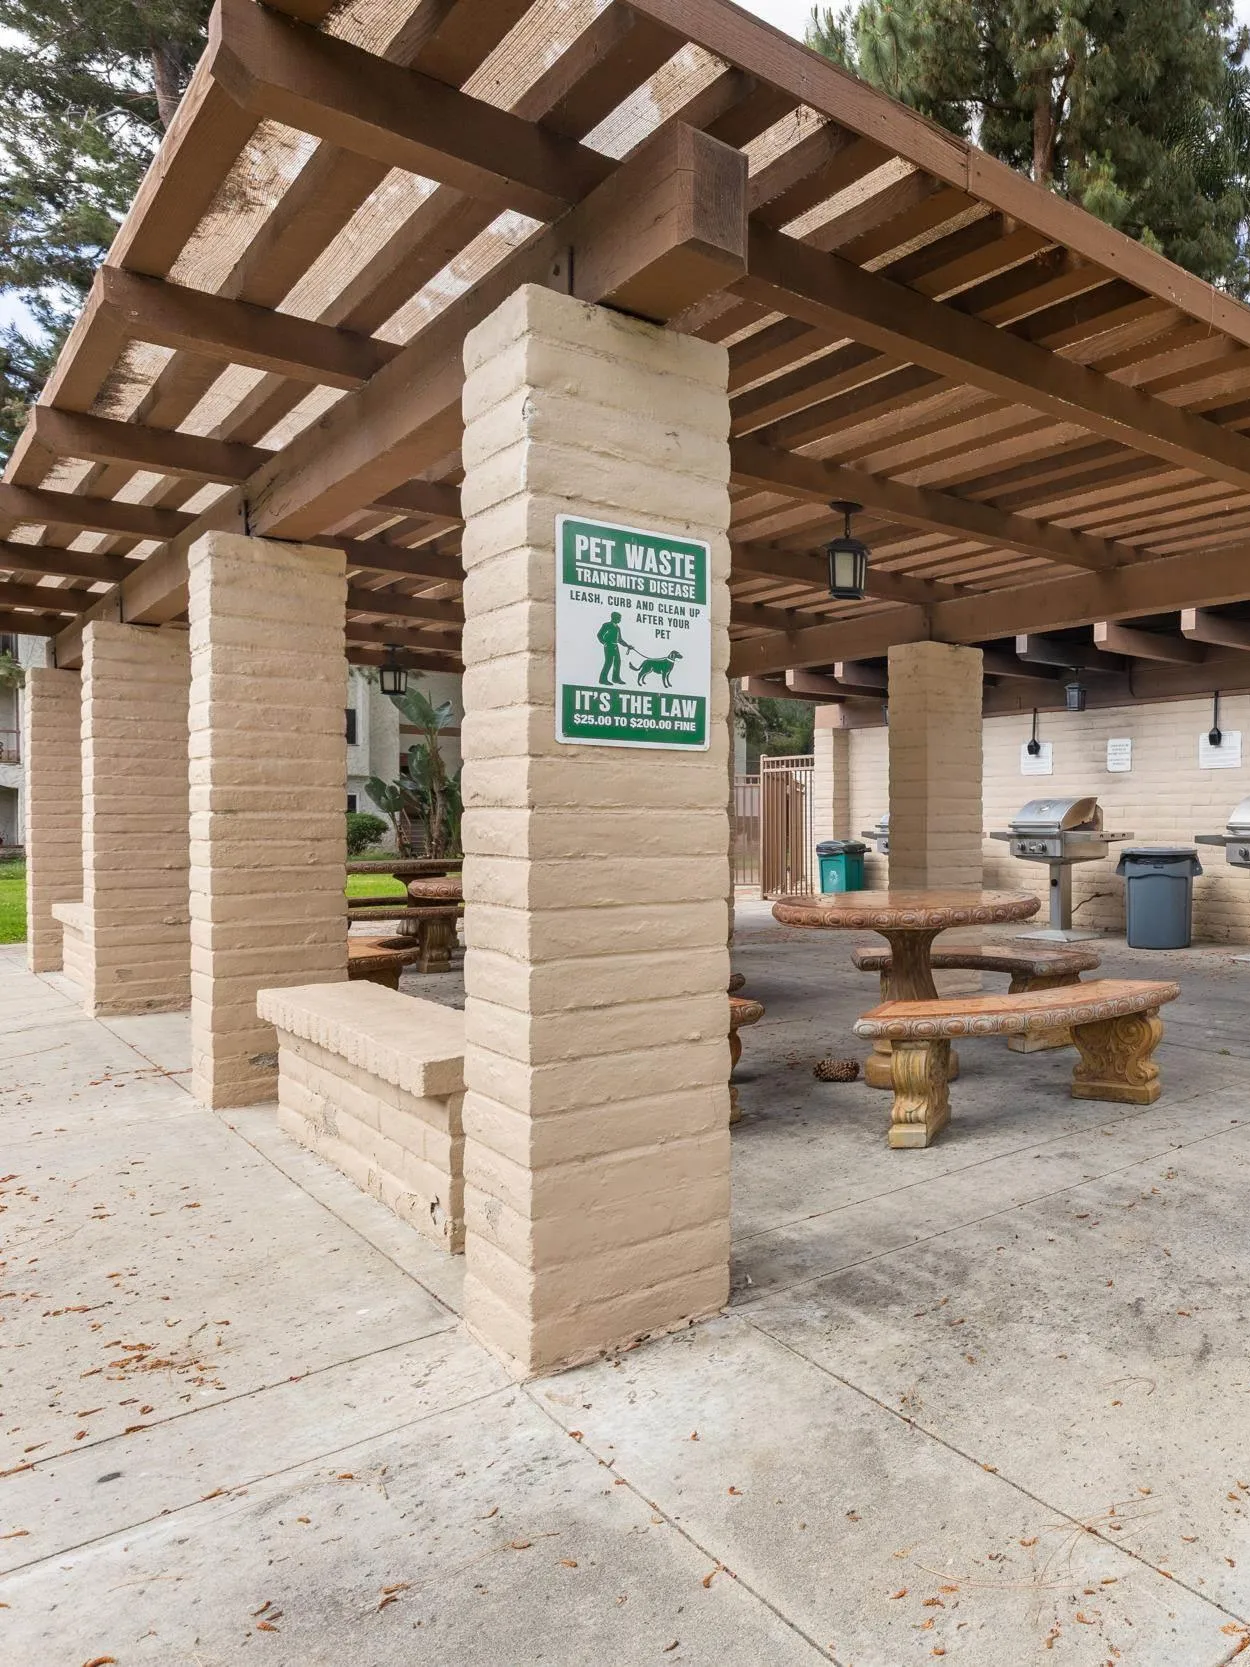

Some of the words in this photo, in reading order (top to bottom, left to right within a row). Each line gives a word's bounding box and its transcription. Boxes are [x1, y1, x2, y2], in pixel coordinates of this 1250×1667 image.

[575, 534, 616, 565] PET
[624, 543, 696, 579] WASTE
[575, 567, 644, 591] TRANSMITS
[649, 581, 696, 599] DISEASE
[607, 595, 632, 609] CURB
[636, 600, 654, 612] AND
[658, 604, 686, 616] CLEAN
[689, 608, 701, 618] UP
[636, 614, 664, 626] AFTER
[668, 617, 690, 630] YOUR
[655, 628, 671, 640] PET
[575, 690, 611, 712] IT'S
[619, 694, 653, 715] THE
[660, 699, 697, 718] LAW
[573, 713, 612, 726] $25.00
[614, 717, 628, 728] TO
[630, 717, 672, 730] $200.00
[674, 720, 696, 732] FINE
